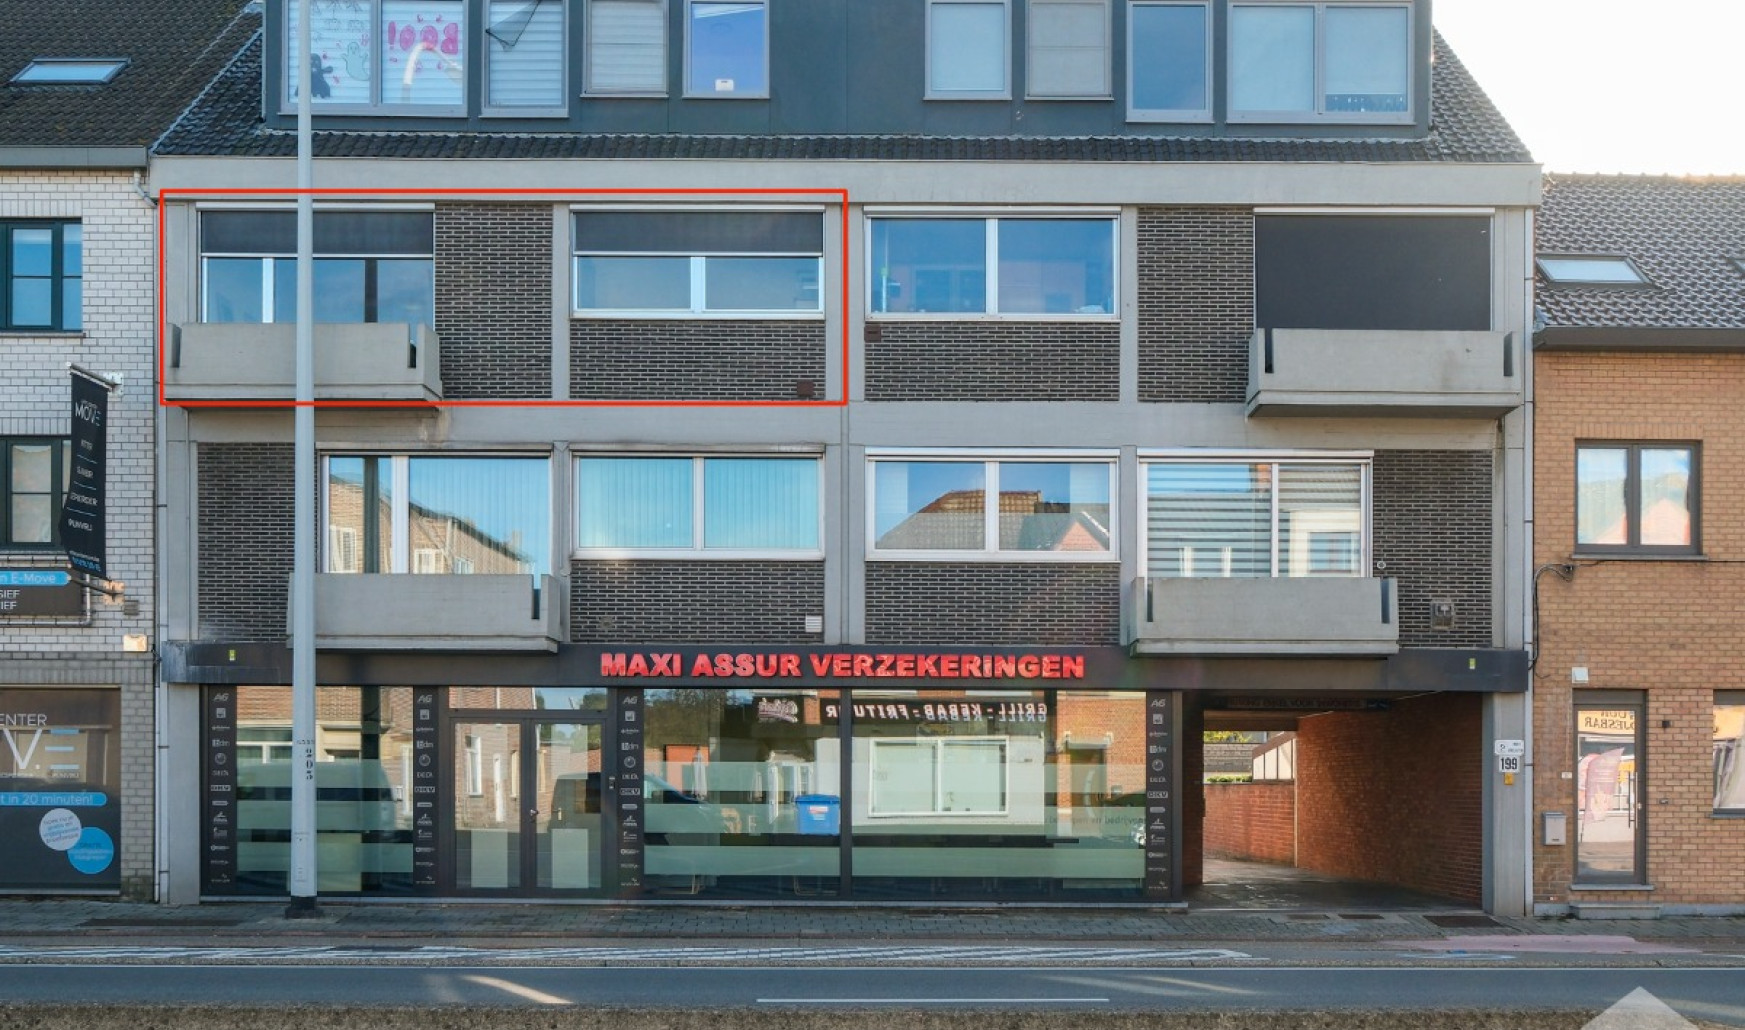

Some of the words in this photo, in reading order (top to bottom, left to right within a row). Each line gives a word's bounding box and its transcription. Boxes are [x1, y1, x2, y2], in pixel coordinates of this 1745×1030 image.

[11, 573, 56, 584] E-Move
[601, 653, 681, 677] MAXI
[691, 653, 802, 677] ASSUR
[809, 653, 1084, 679] VERZEKERINGEN
[1501, 757, 1518, 770] 199
[8, 793, 19, 804] in
[22, 793, 38, 804] 20
[42, 793, 93, 804] minuten!
